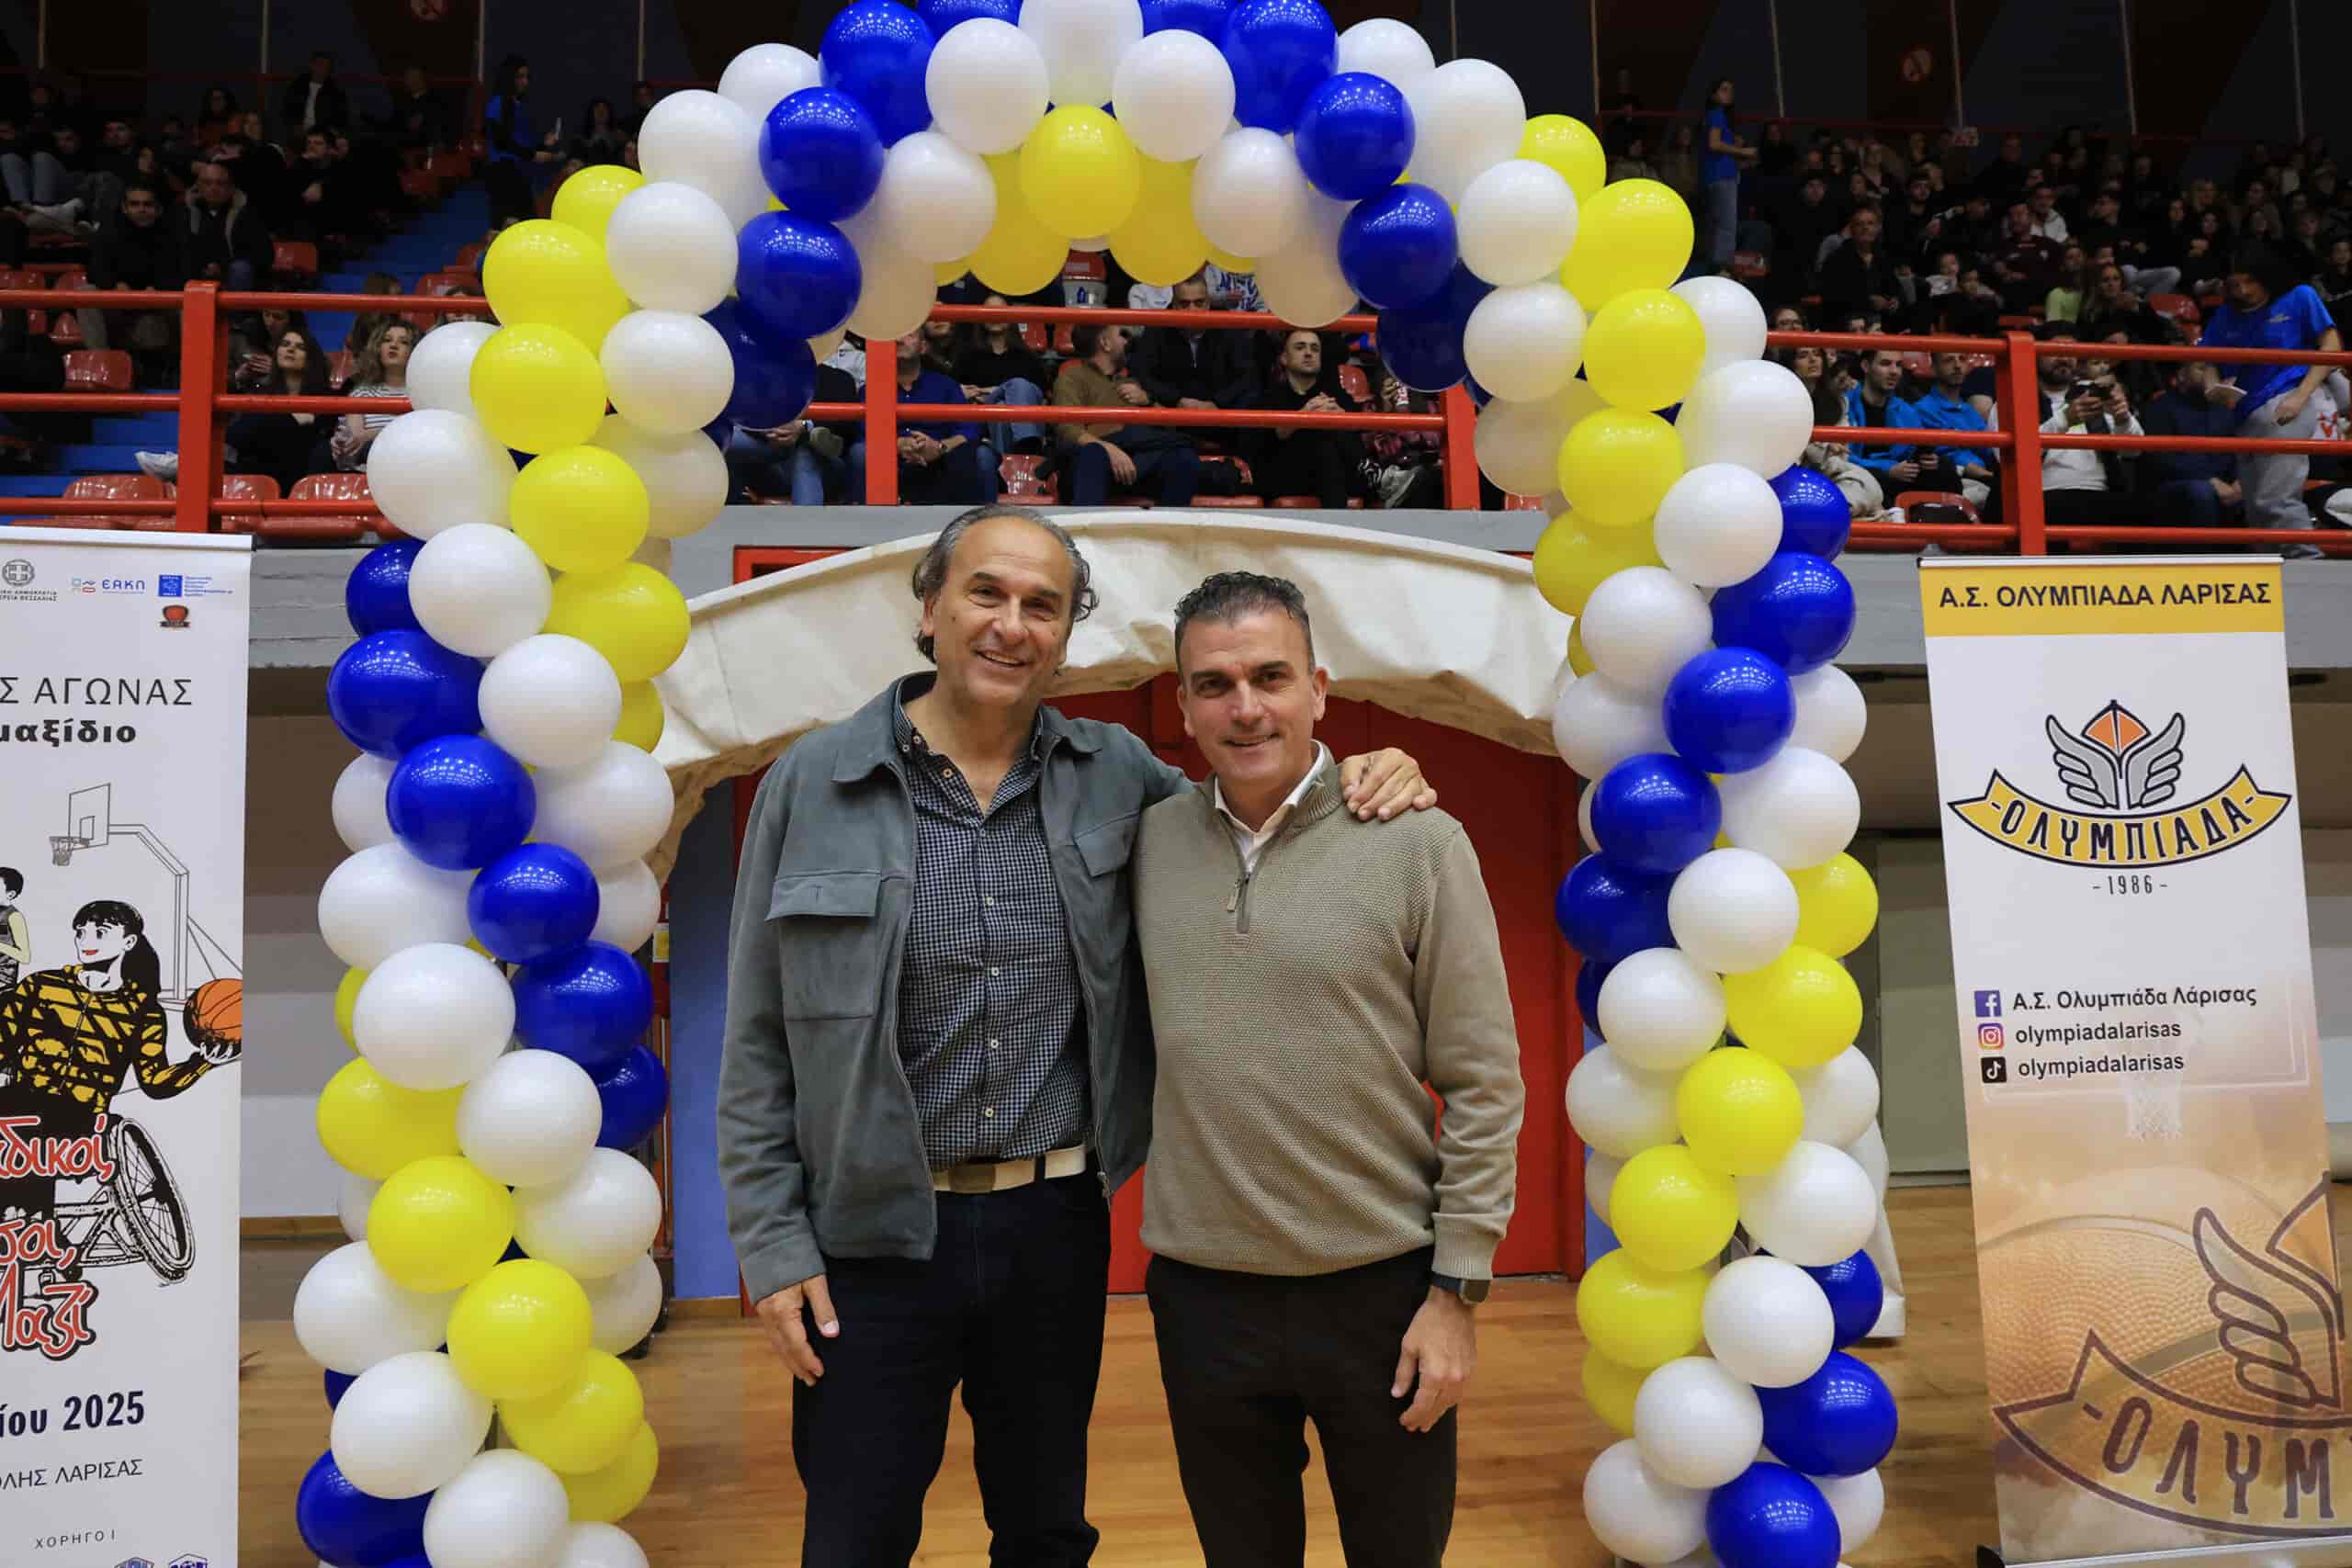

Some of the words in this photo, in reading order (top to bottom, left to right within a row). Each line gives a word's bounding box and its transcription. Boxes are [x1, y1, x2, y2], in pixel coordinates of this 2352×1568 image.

[1939, 586, 1988, 607] Α.Σ.
[1996, 584, 2154, 607] ΟΛΥΜΠΙΑΔΑ
[2161, 582, 2272, 605] ΛΑΡΙΣΑΣ
[34, 677, 192, 705] ΑΓΩΝΑΣ
[2013, 992, 2051, 1010] Α.Σ.
[2057, 987, 2167, 1011] Ολυμπιάδα
[2174, 986, 2256, 1007] Λάρισας
[2016, 1021, 2182, 1046] olympiadalarisas
[2018, 1054, 2184, 1079] olympiadalarisas
[62, 1390, 144, 1431] 2025
[0, 1469, 48, 1490] ΛΗΣ
[55, 1459, 143, 1484] ΛΑΡΙΣΑΣ
